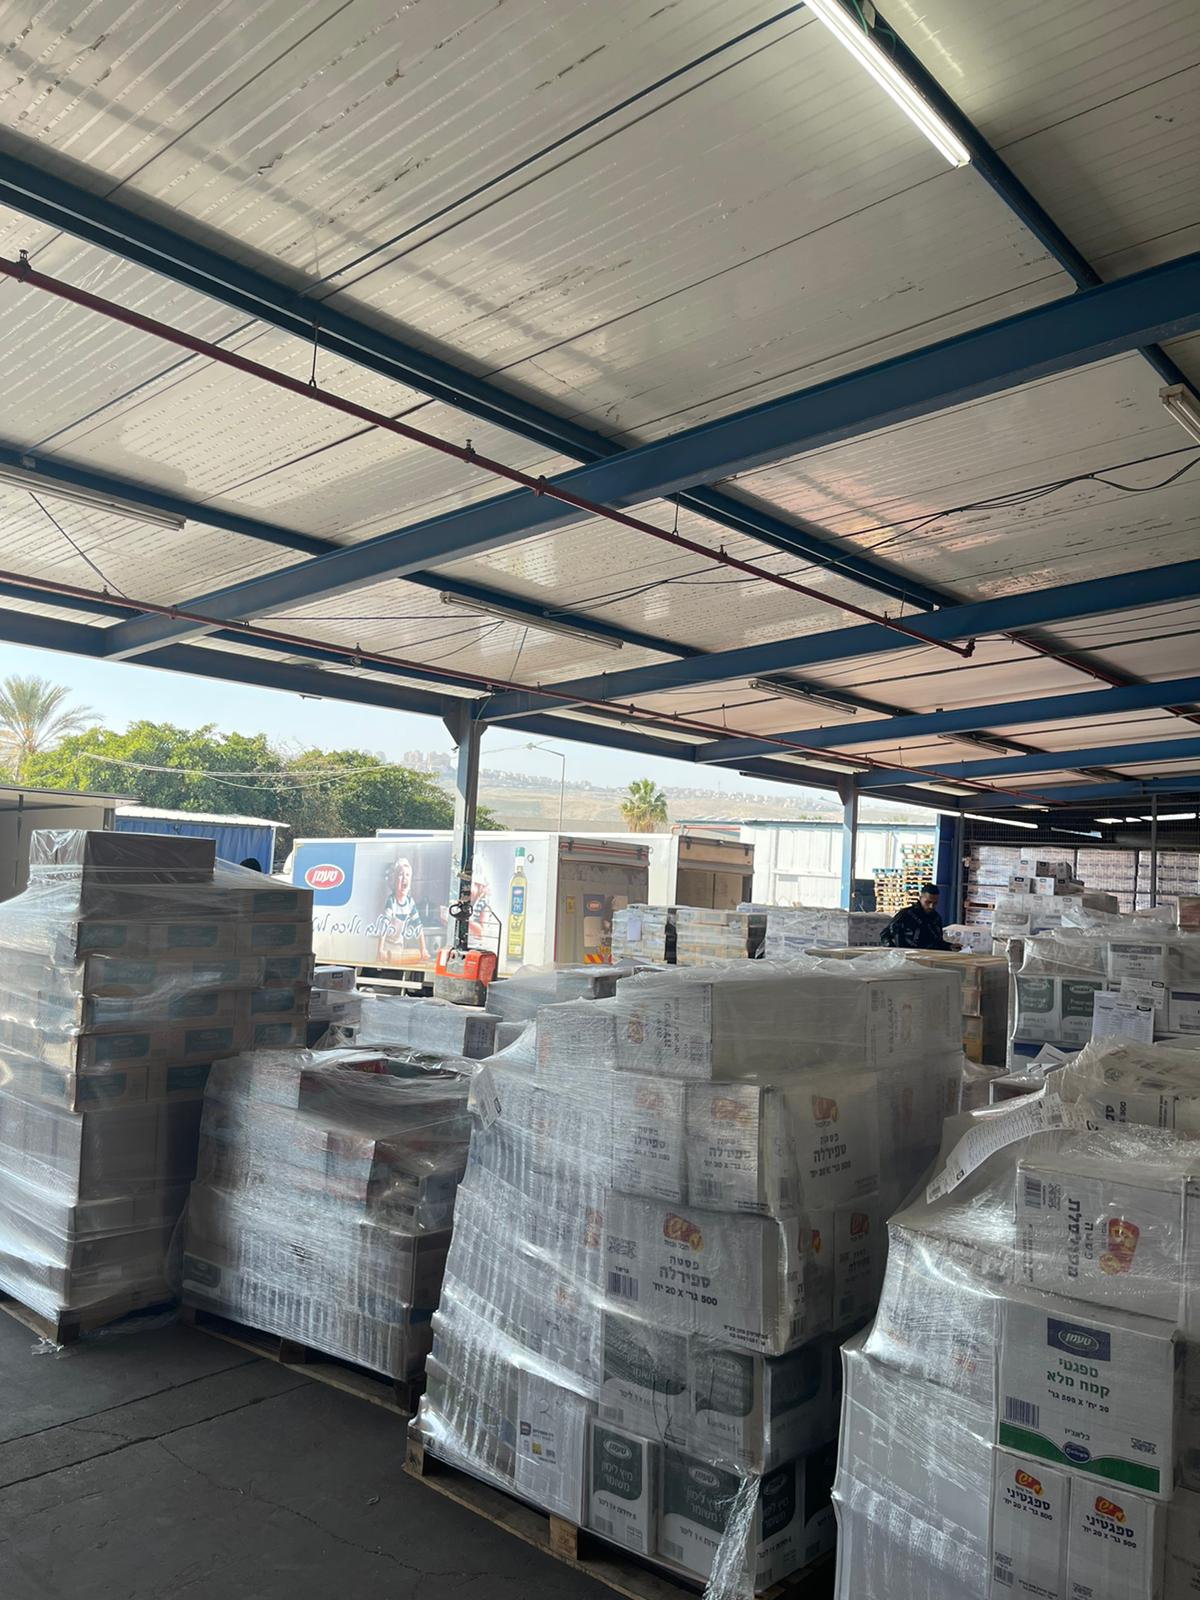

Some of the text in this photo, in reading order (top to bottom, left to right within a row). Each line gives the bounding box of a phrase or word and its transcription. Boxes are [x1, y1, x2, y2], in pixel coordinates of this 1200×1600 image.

[311, 870, 338, 884] טעמן
[331, 913, 362, 935] אליכם
[669, 1255, 700, 1271] פסטה
[659, 1266, 711, 1289] ספירלה
[665, 1286, 676, 1295] 20
[700, 1294, 718, 1306] 500
[1065, 1332, 1092, 1346] טעמן
[1058, 1357, 1099, 1378] ספגטי
[1046, 1370, 1111, 1399] קמח מלא
[1099, 1404, 1110, 1413] 20
[1006, 1487, 1051, 1511] ספגטיני
[1012, 1501, 1022, 1509] 20
[1040, 1511, 1053, 1521] 500
[1085, 1514, 1135, 1538] ספגטיני
[1093, 1529, 1103, 1537] 20
[1123, 1539, 1137, 1549] 500
